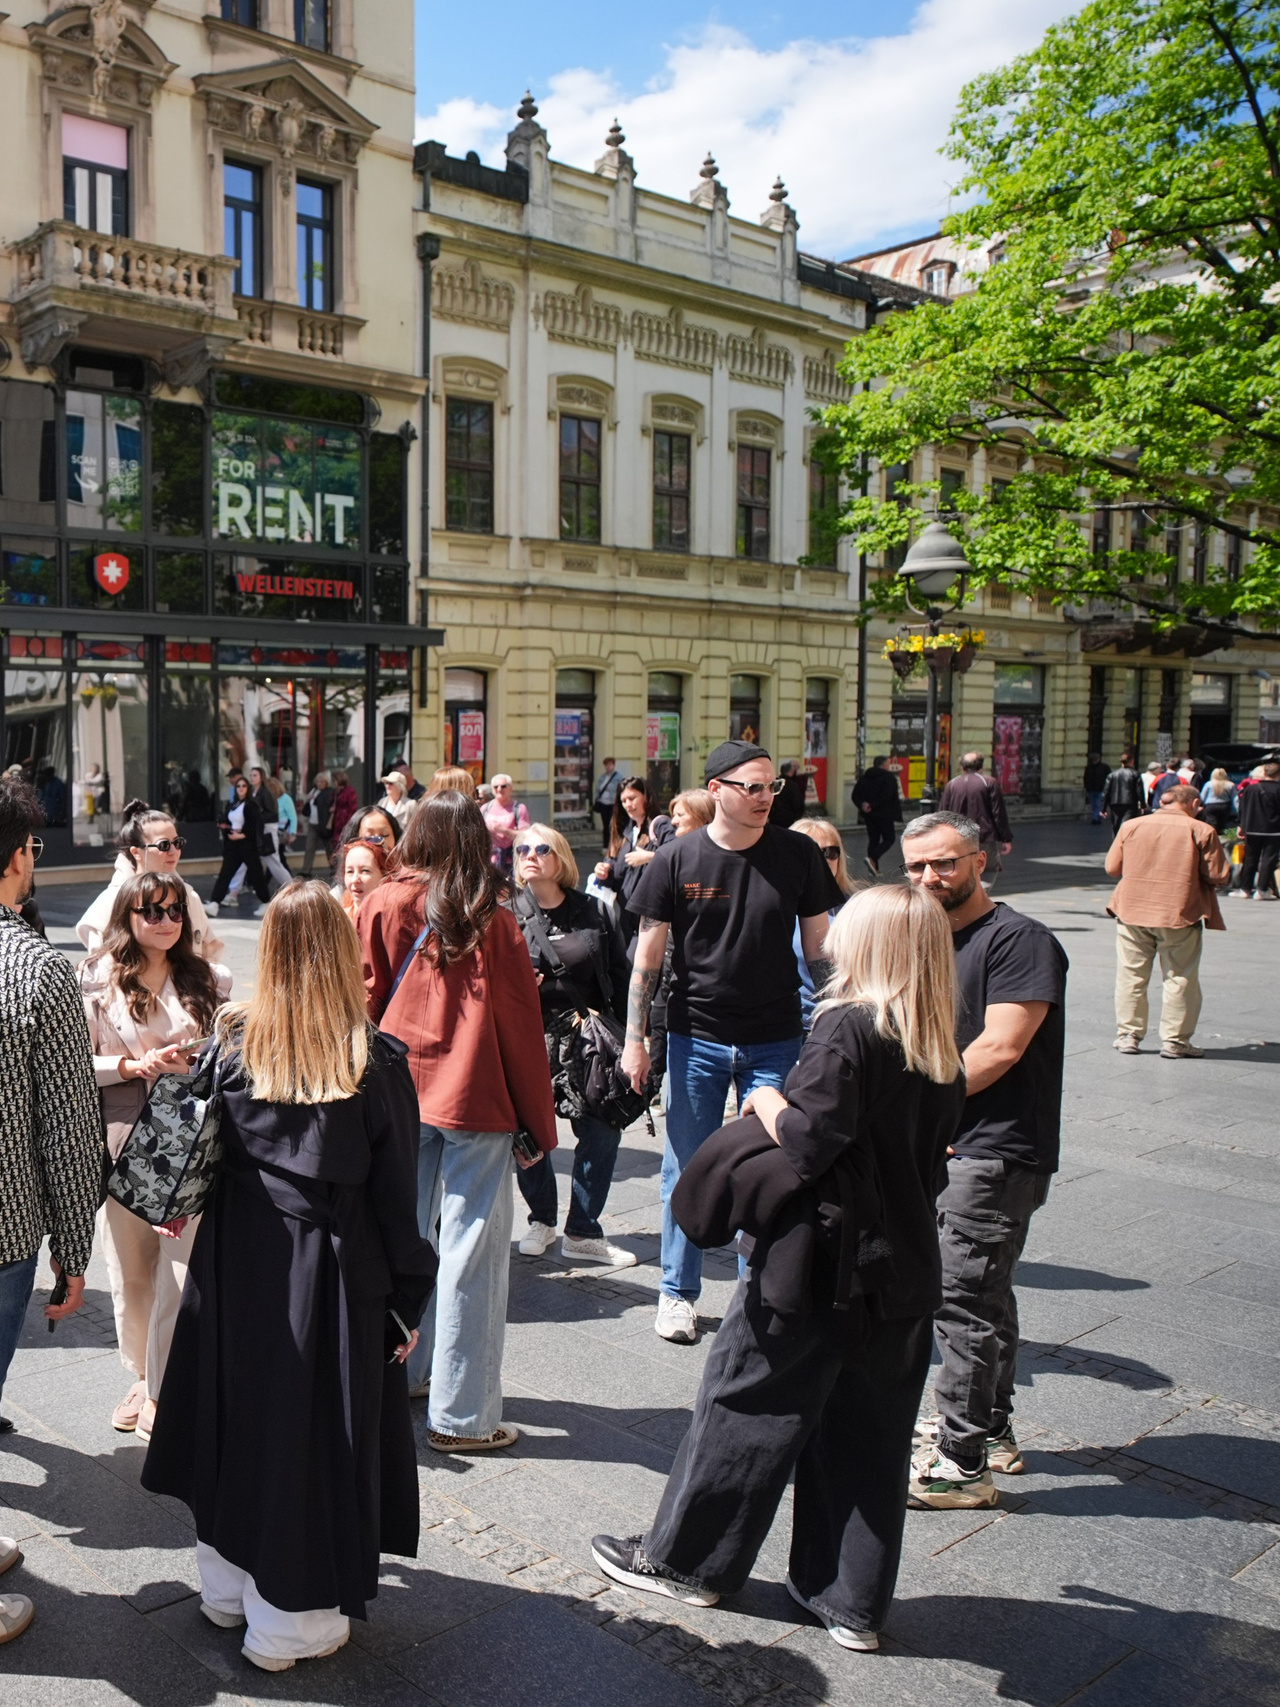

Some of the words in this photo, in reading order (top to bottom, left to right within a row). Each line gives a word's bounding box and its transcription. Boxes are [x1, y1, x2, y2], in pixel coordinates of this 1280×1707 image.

[218, 457, 256, 480] FOR
[218, 481, 355, 544] RENT
[236, 573, 354, 600] WELLENSTEYN
